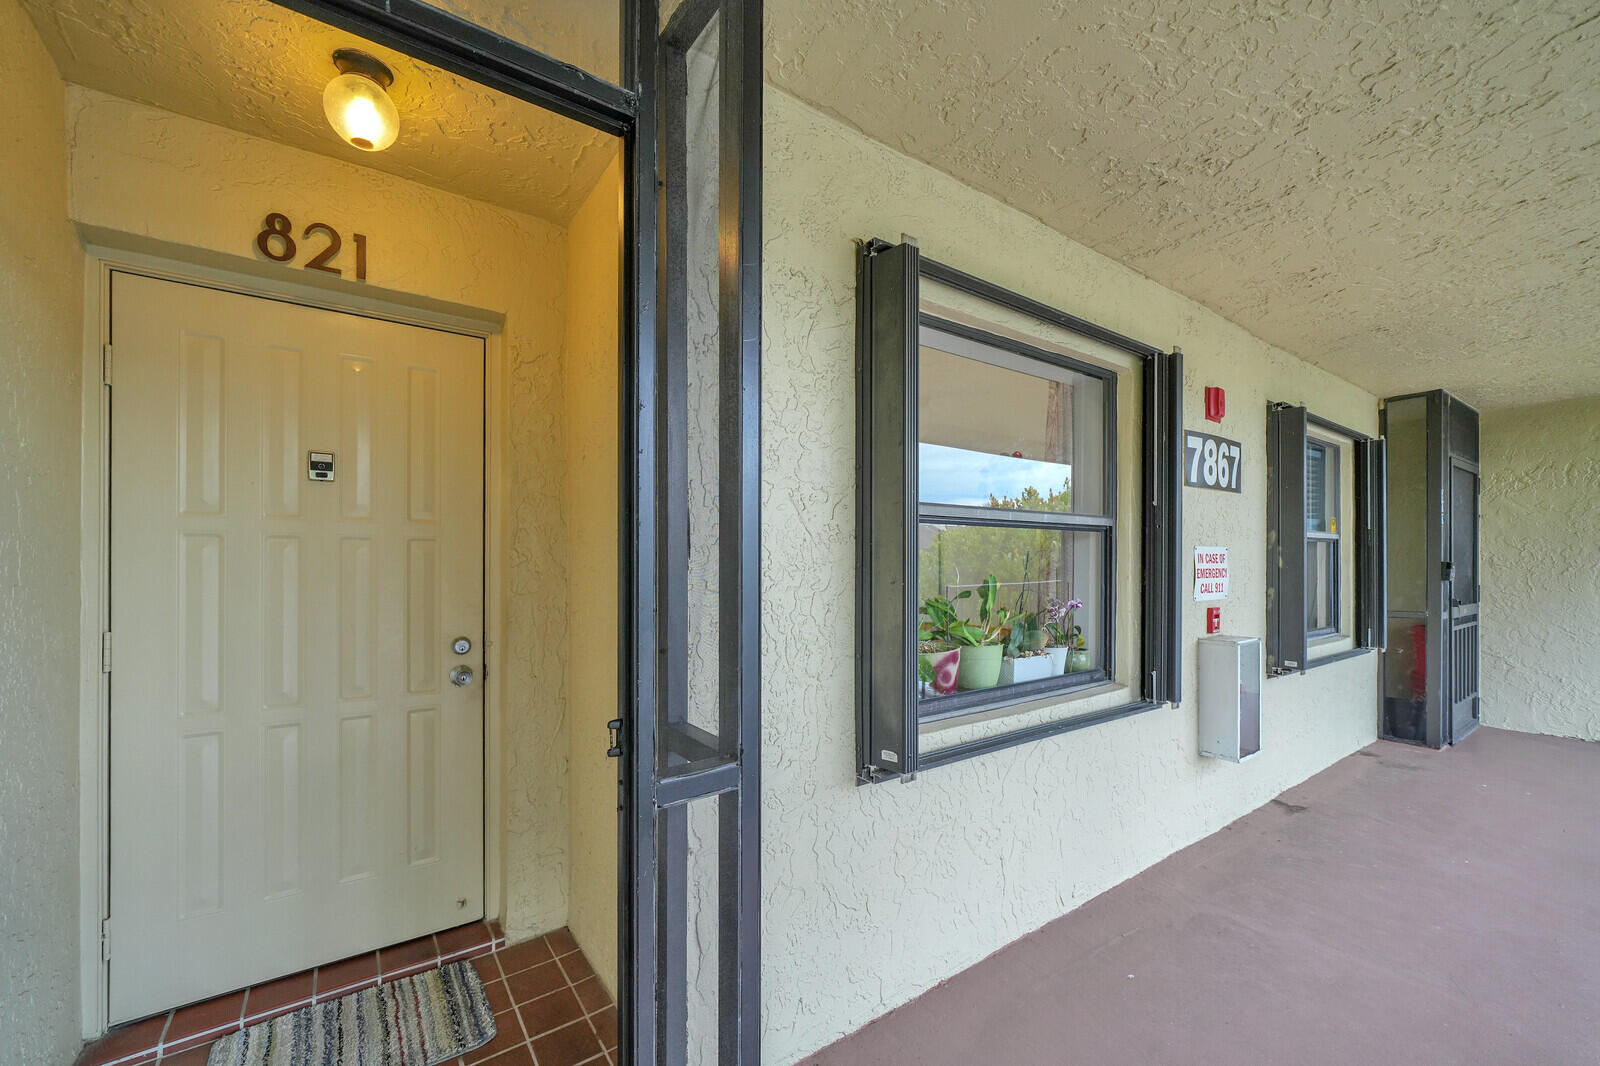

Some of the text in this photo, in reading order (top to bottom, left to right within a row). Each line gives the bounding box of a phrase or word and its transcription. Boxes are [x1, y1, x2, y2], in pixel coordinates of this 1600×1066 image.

[257, 212, 367, 280] 821
[1187, 435, 1240, 489] 7867
[1197, 553, 1226, 564] IN CASE OF
[1196, 567, 1228, 579] EMERGENCY
[1200, 582, 1224, 594] CALL 911
